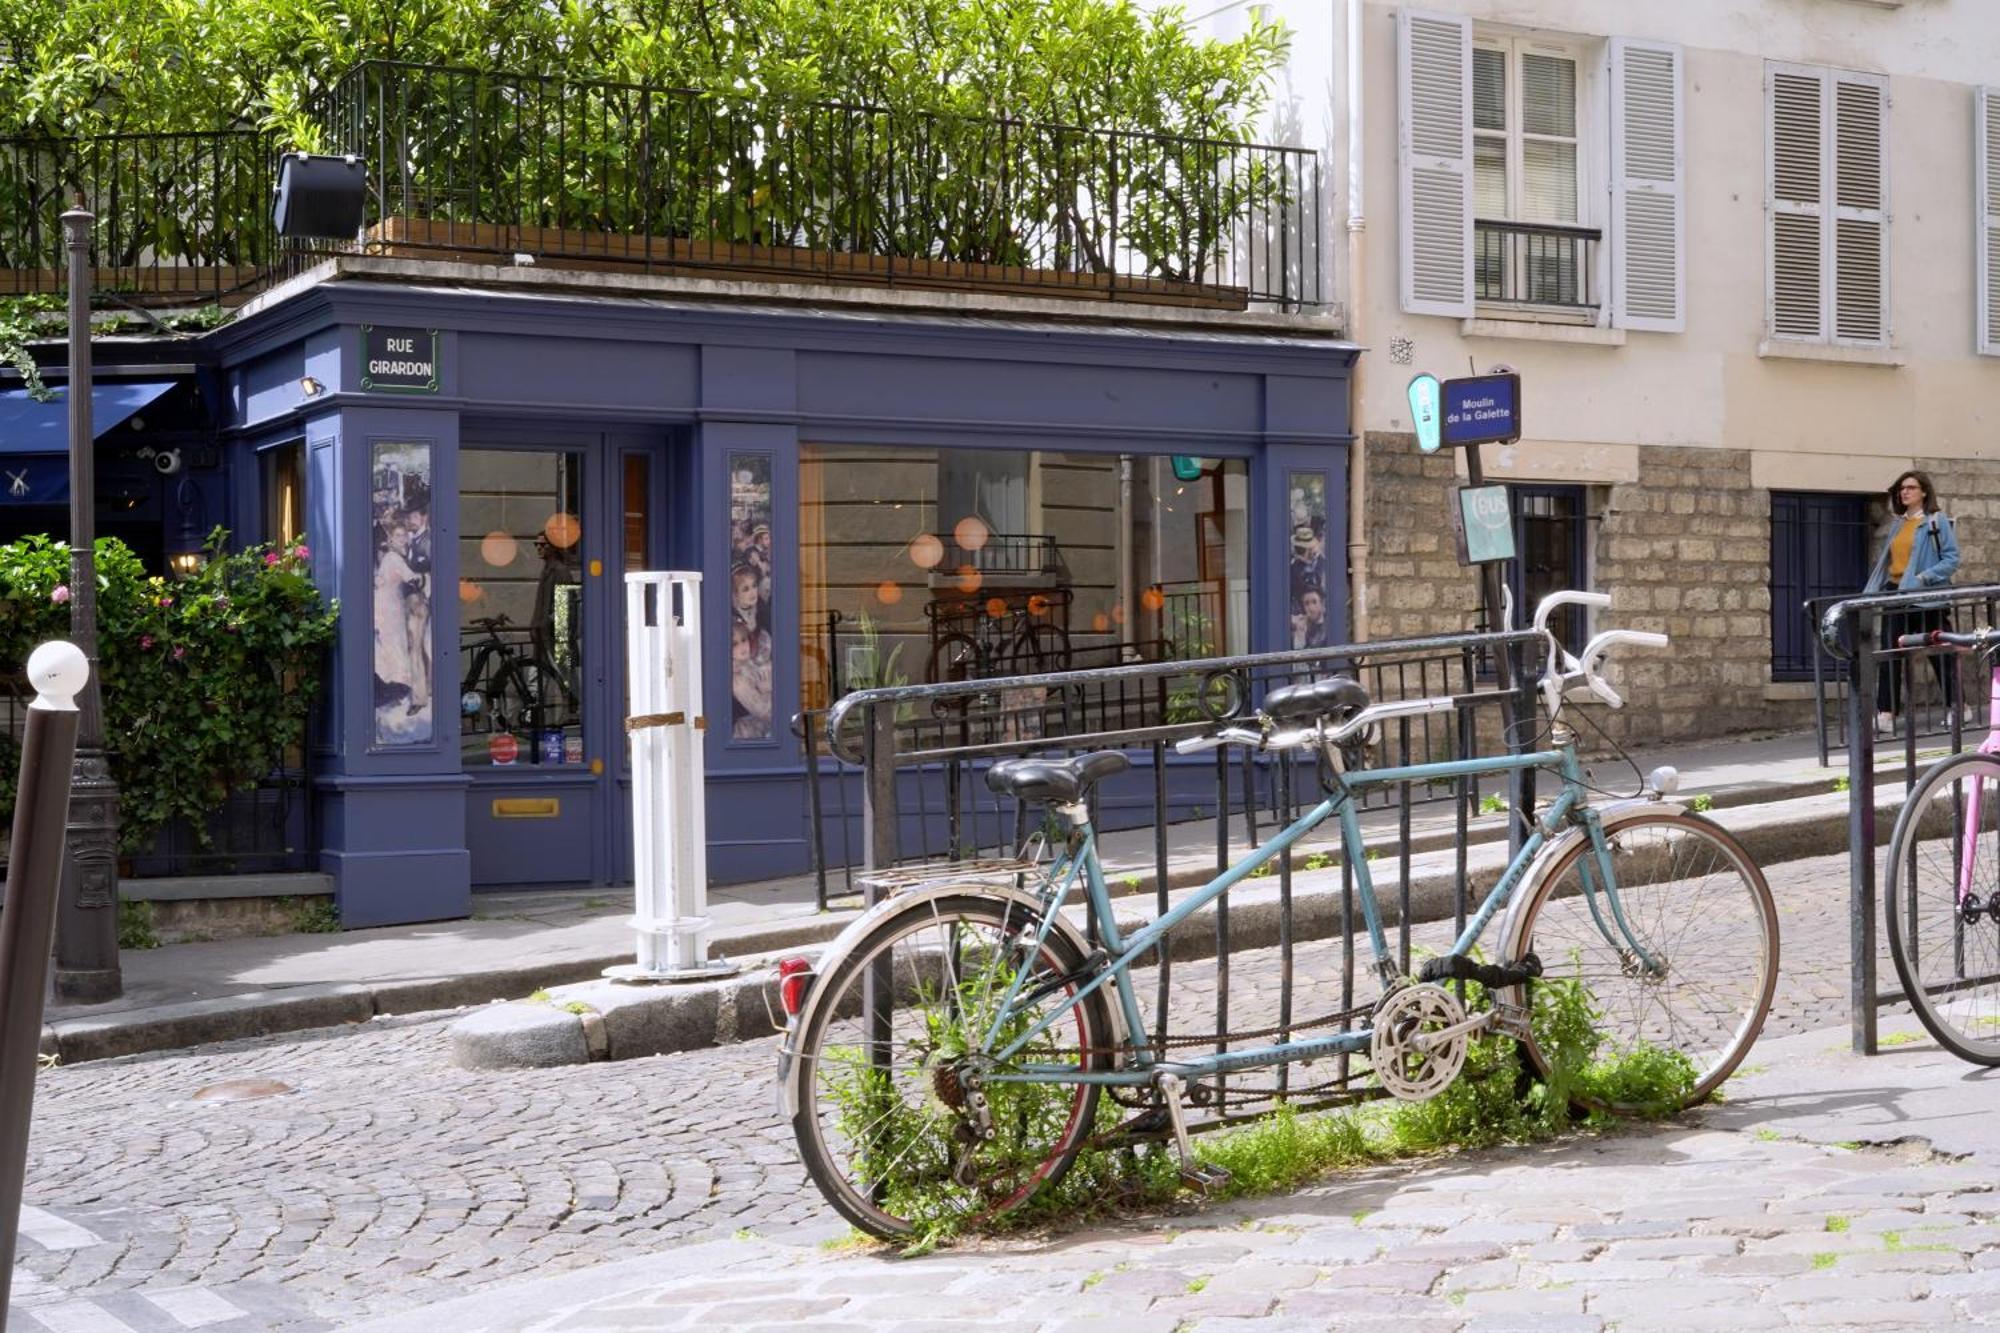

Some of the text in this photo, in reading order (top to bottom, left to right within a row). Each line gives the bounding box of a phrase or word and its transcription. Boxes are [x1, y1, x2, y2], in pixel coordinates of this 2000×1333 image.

[387, 338, 414, 353] RUE
[369, 360, 432, 377] GIRARDON
[1462, 398, 1494, 410] Moulin
[1447, 408, 1510, 423] de la Galette
